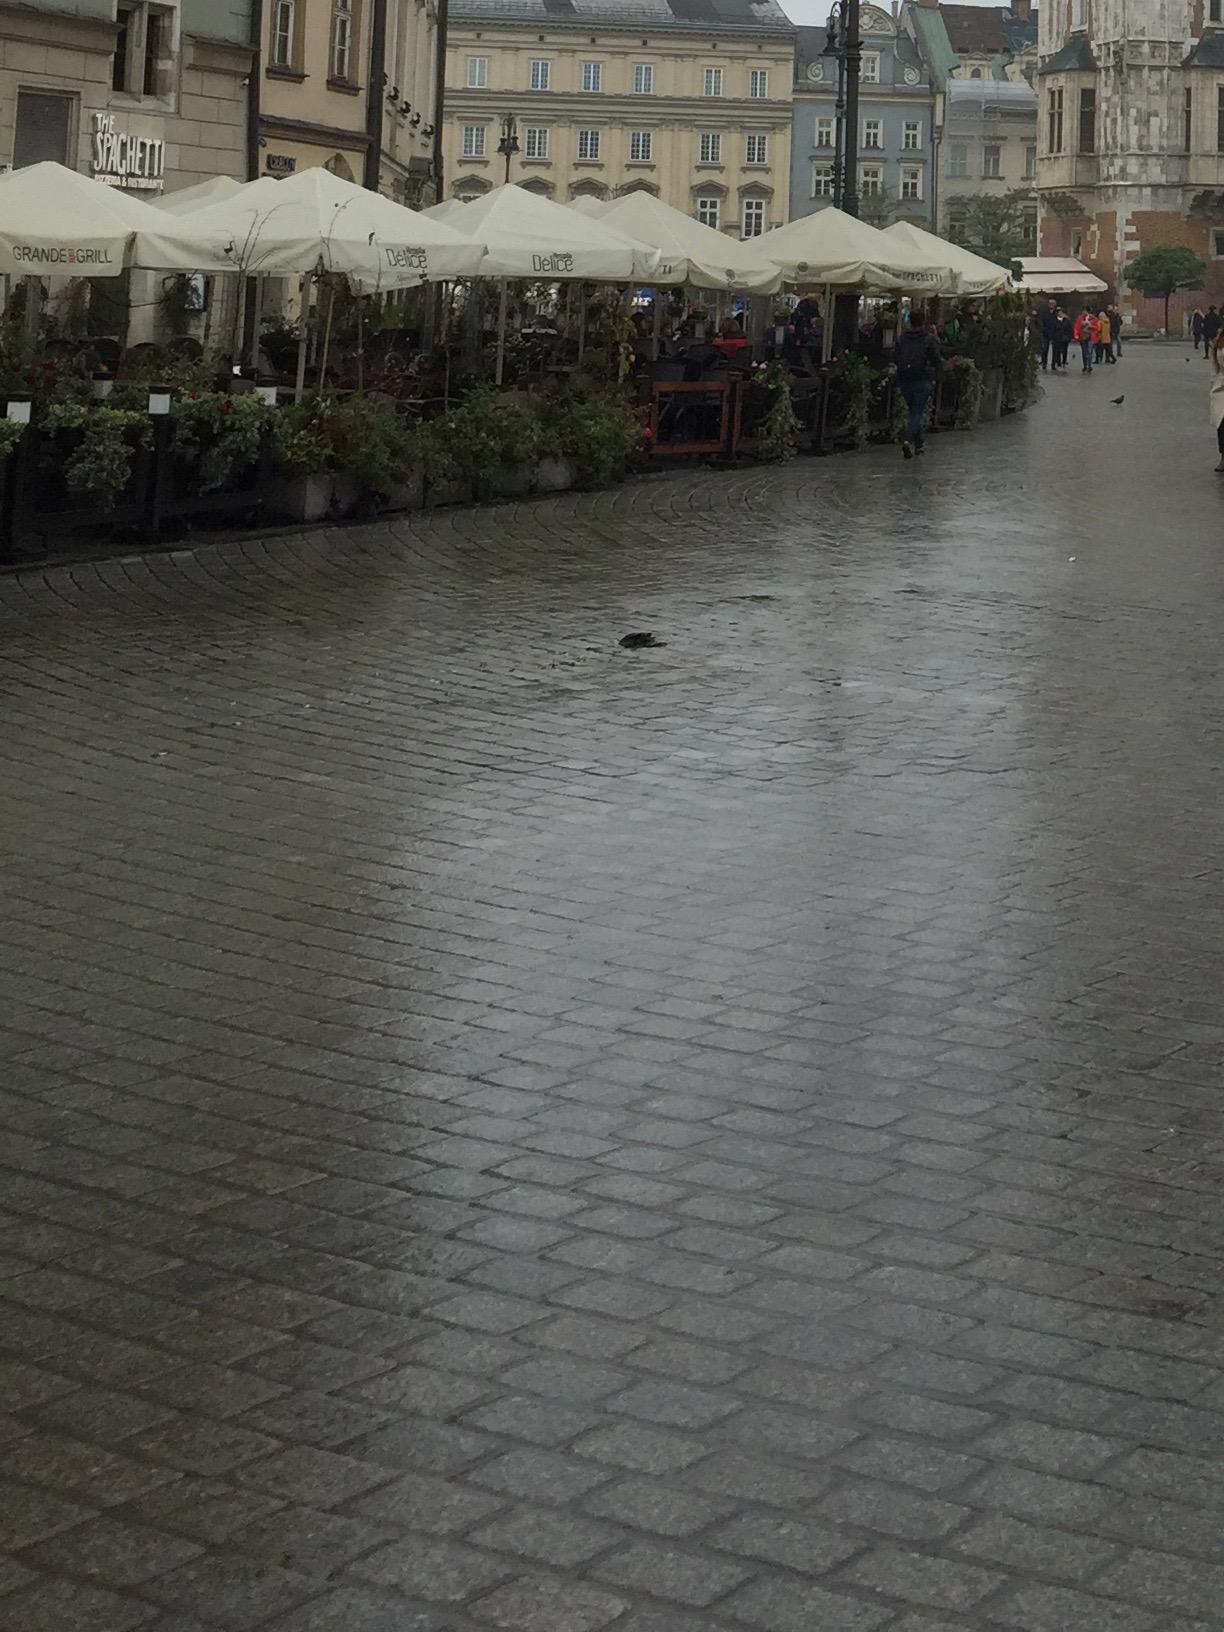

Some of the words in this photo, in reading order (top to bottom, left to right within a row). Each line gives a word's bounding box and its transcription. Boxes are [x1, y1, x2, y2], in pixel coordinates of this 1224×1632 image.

[95, 113, 115, 134] THE
[93, 132, 165, 176] SPAGHETTI
[12, 245, 67, 263] GRANDE
[76, 248, 113, 264] GRILL
